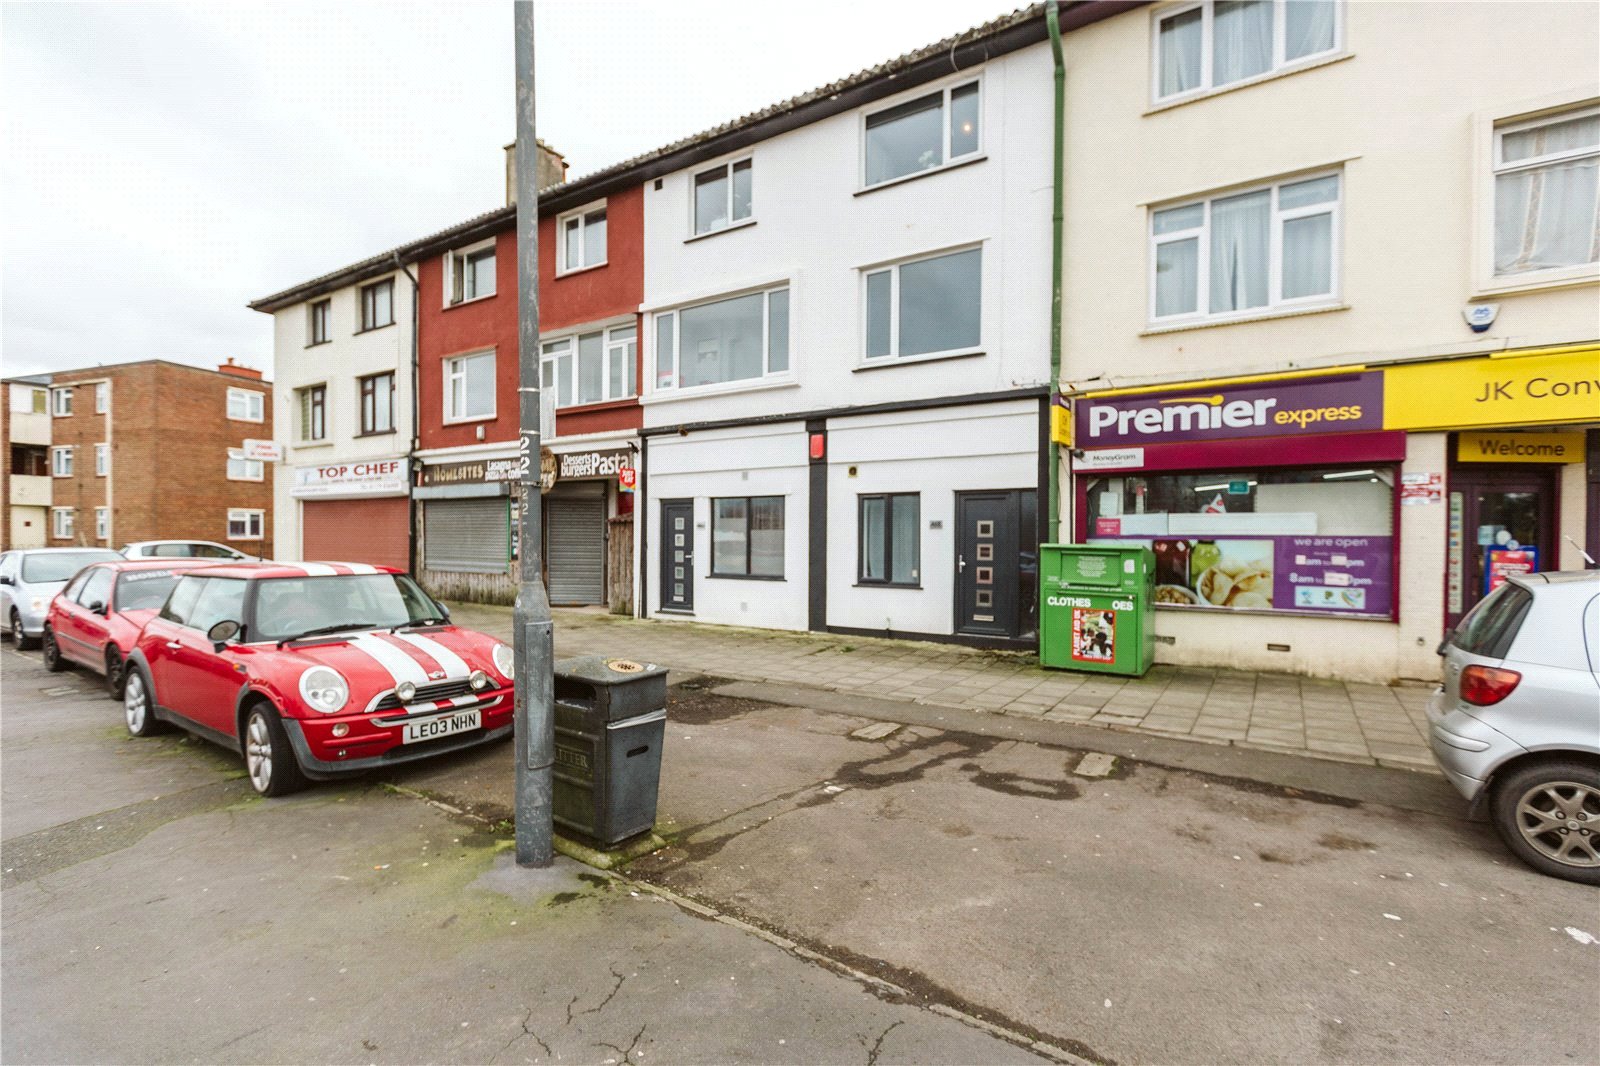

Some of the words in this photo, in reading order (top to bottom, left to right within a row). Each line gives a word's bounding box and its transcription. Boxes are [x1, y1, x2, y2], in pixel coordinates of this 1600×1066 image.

[1475, 380, 1514, 402] JK
[1089, 395, 1277, 437] Premier
[1274, 405, 1363, 429] express
[1479, 439, 1566, 457] Welcome
[563, 454, 592, 466] Desserts
[592, 452, 629, 476] Pasta
[317, 466, 347, 479] TOP
[353, 461, 399, 477] CHEF
[561, 462, 592, 478] burgers
[1294, 538, 1311, 546] we
[1314, 538, 1333, 546] are
[1335, 538, 1368, 548] open
[1047, 596, 1092, 608] CLOTHES
[1112, 600, 1134, 611] OES
[409, 720, 448, 740] LE03
[450, 712, 477, 731] NHN
